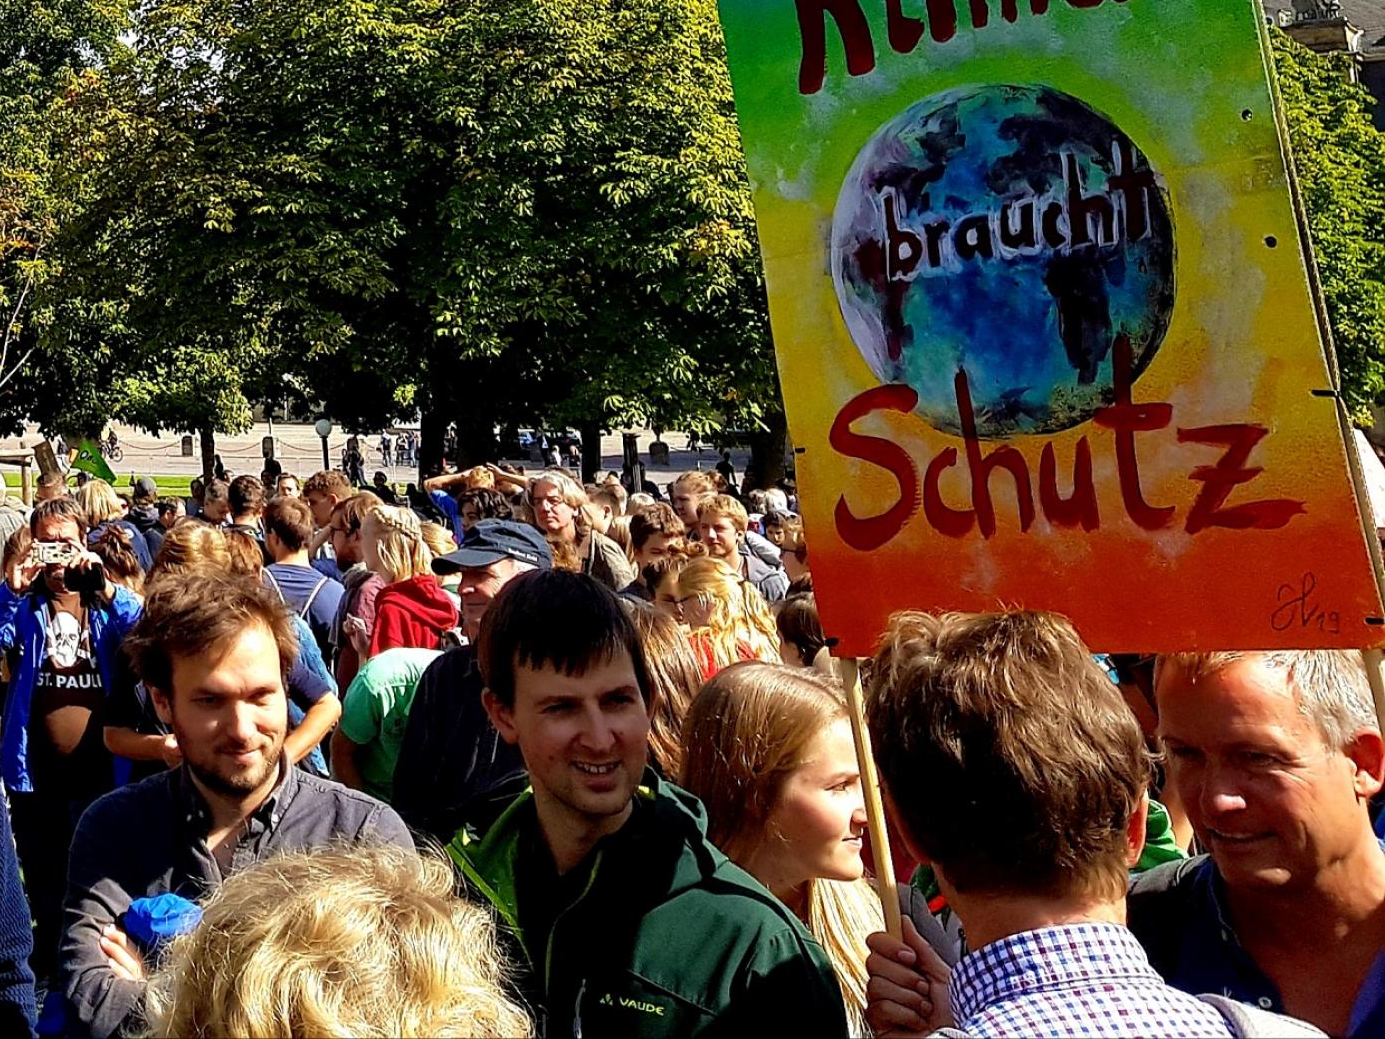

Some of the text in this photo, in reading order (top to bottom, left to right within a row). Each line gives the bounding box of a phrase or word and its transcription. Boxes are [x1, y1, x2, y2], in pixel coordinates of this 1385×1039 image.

[882, 142, 1166, 282] braucht
[829, 333, 1307, 550] Schutz
[37, 672, 102, 689] ST. PAULI
[619, 996, 665, 1016] VAUDE
